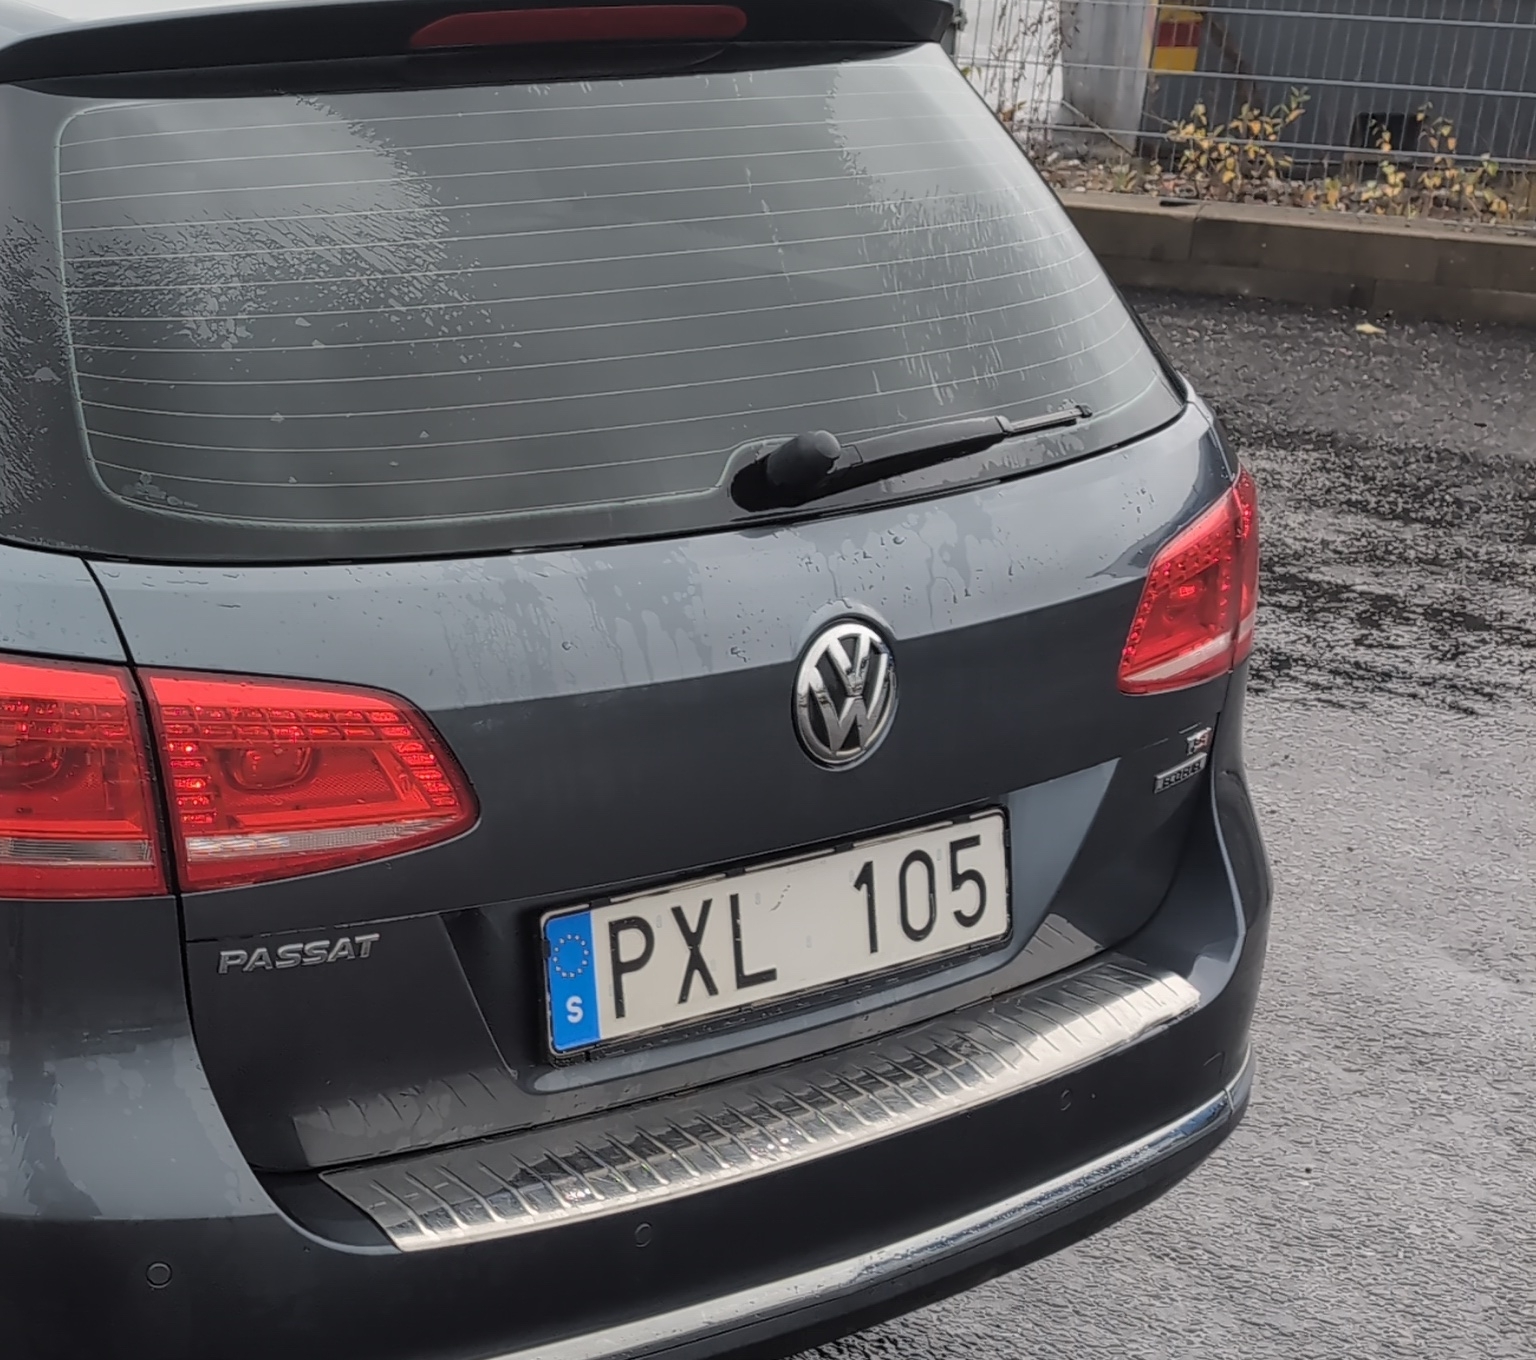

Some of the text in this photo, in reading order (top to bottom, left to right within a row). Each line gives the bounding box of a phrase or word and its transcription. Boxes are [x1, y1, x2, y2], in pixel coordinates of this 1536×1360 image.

[608, 834, 987, 1019] PXL 105
[217, 932, 381, 975] PASSAT
[565, 995, 584, 1024] S
